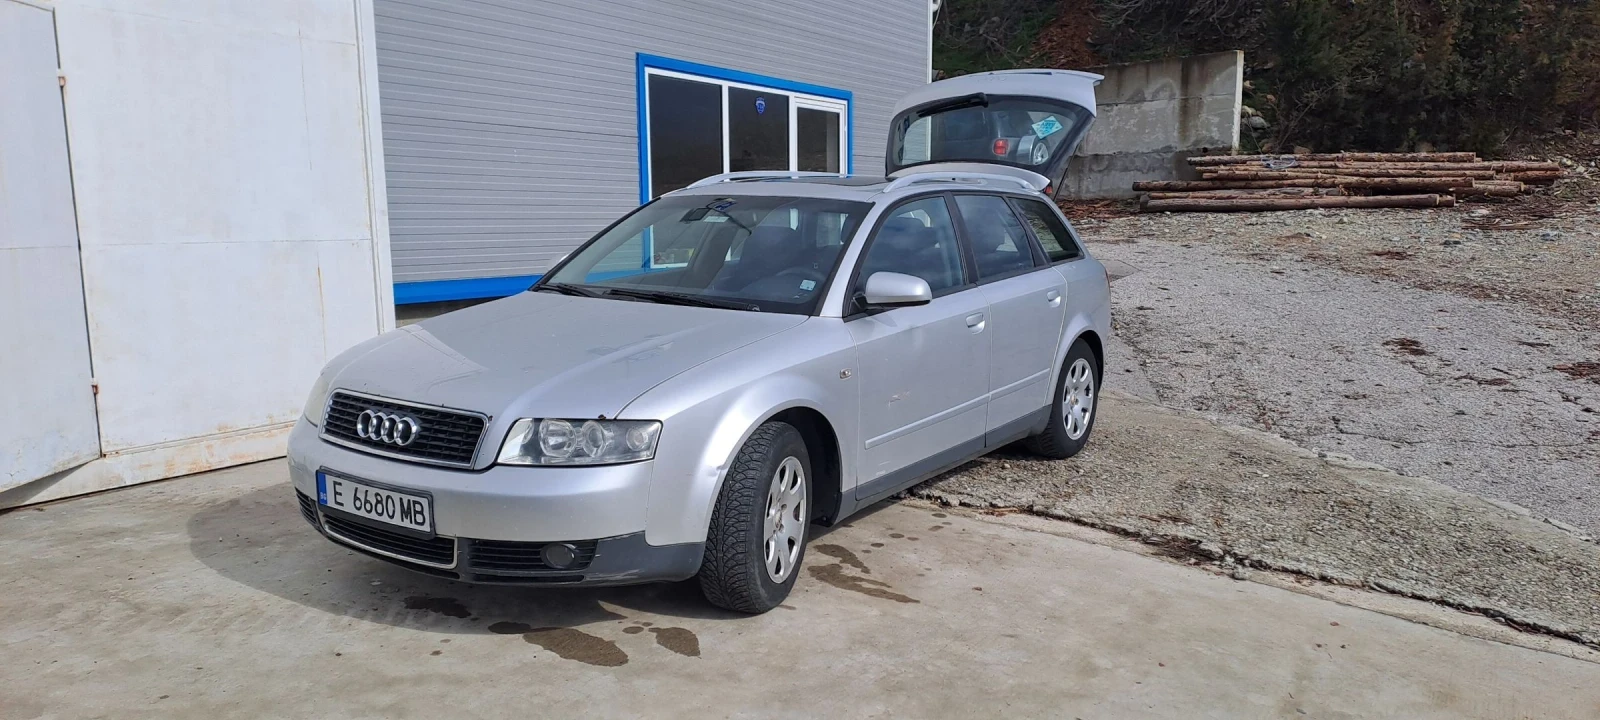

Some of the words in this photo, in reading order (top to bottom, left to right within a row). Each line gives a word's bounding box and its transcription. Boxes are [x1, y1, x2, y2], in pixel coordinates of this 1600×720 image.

[333, 481, 344, 506] E
[353, 487, 395, 519] 6680
[399, 497, 426, 526] MB
